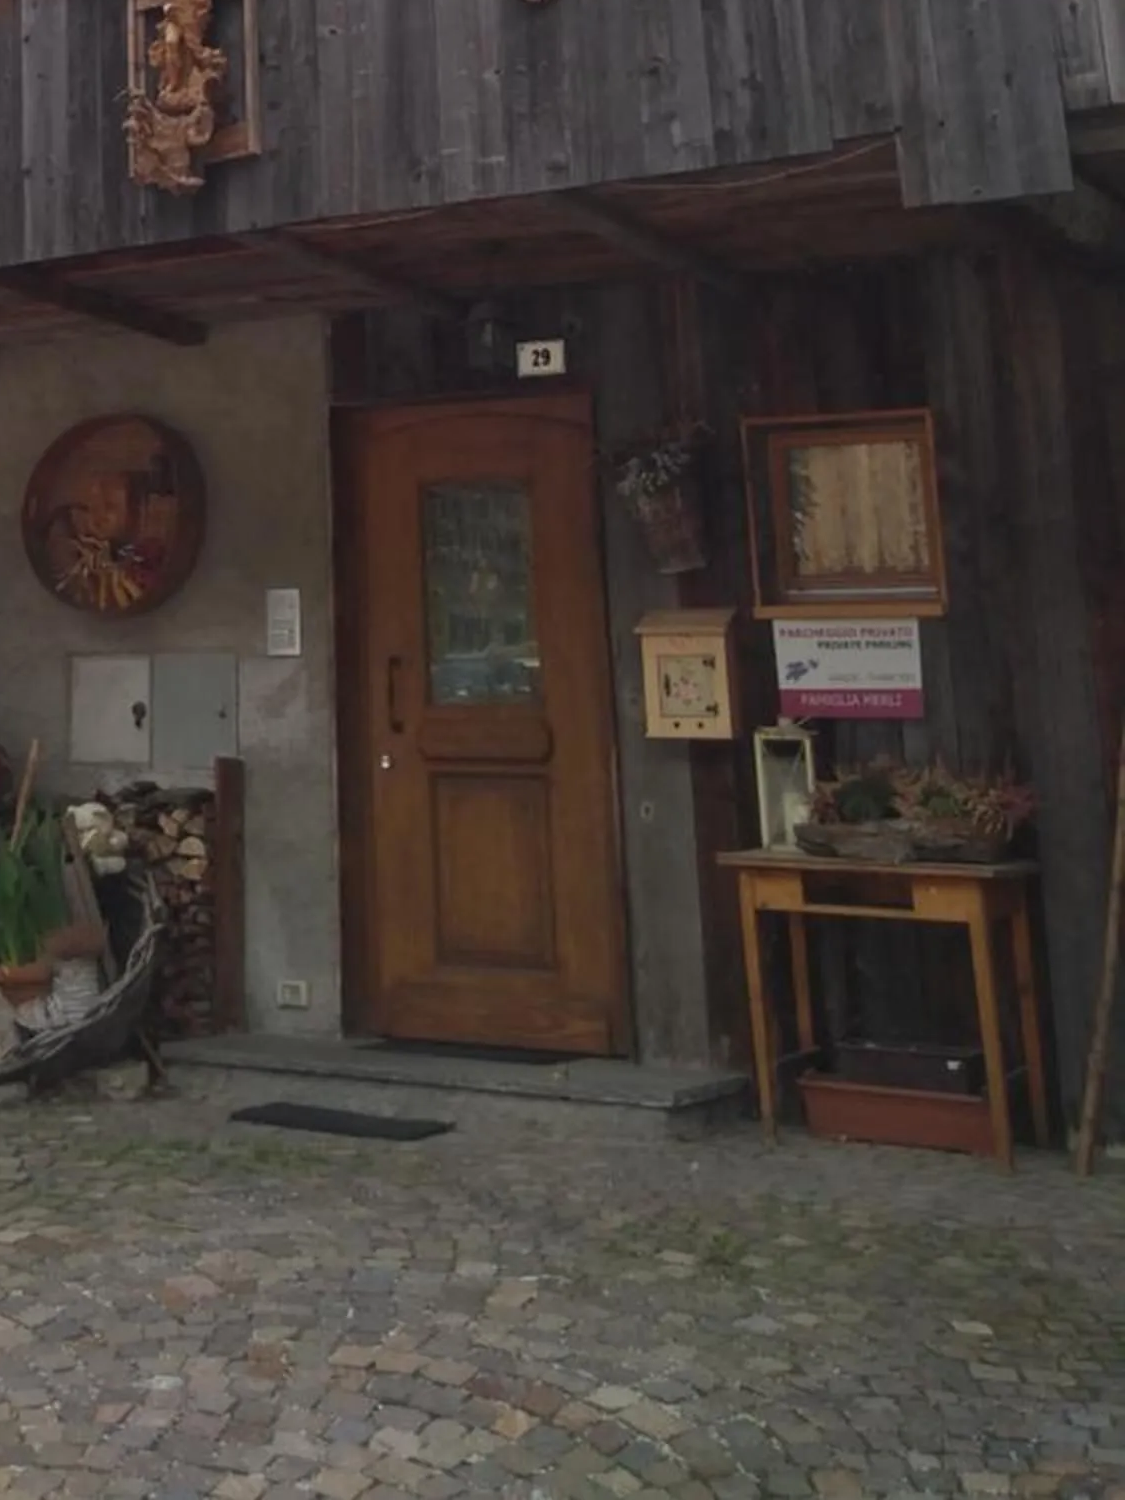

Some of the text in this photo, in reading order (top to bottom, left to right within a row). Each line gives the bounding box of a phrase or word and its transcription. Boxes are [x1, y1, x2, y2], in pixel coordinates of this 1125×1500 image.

[531, 348, 551, 367] 29
[860, 626, 914, 638] PRIVATO
[816, 640, 913, 650] PRIVATE PARKING
[800, 693, 860, 707] FAMIGLIA
